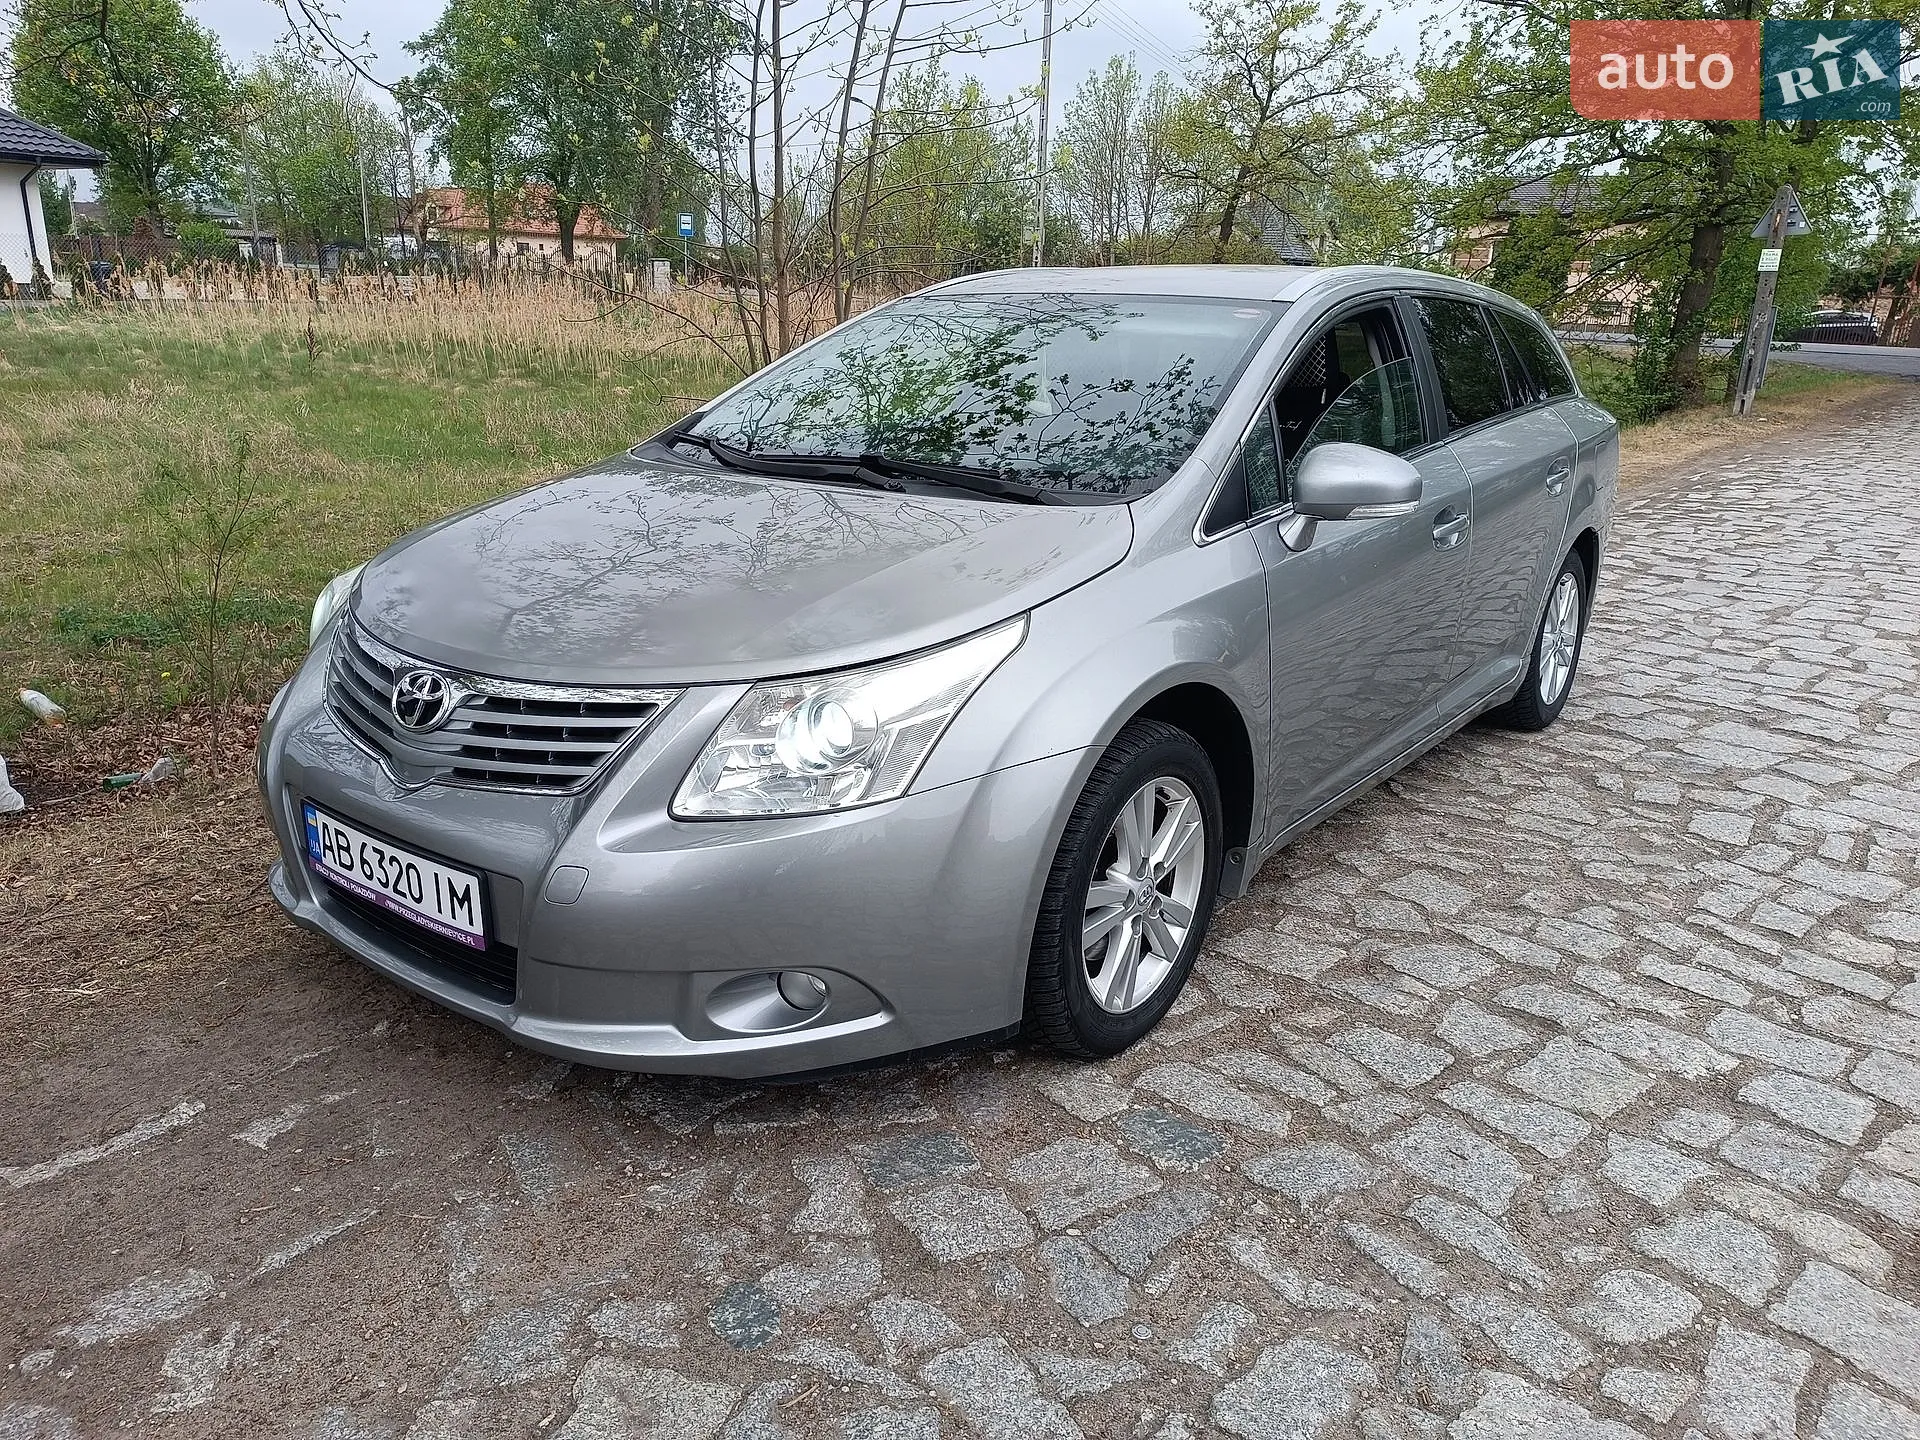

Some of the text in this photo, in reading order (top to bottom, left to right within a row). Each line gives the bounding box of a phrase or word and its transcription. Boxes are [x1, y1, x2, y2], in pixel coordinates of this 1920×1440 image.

[322, 821, 475, 927] AB 6320 IM
